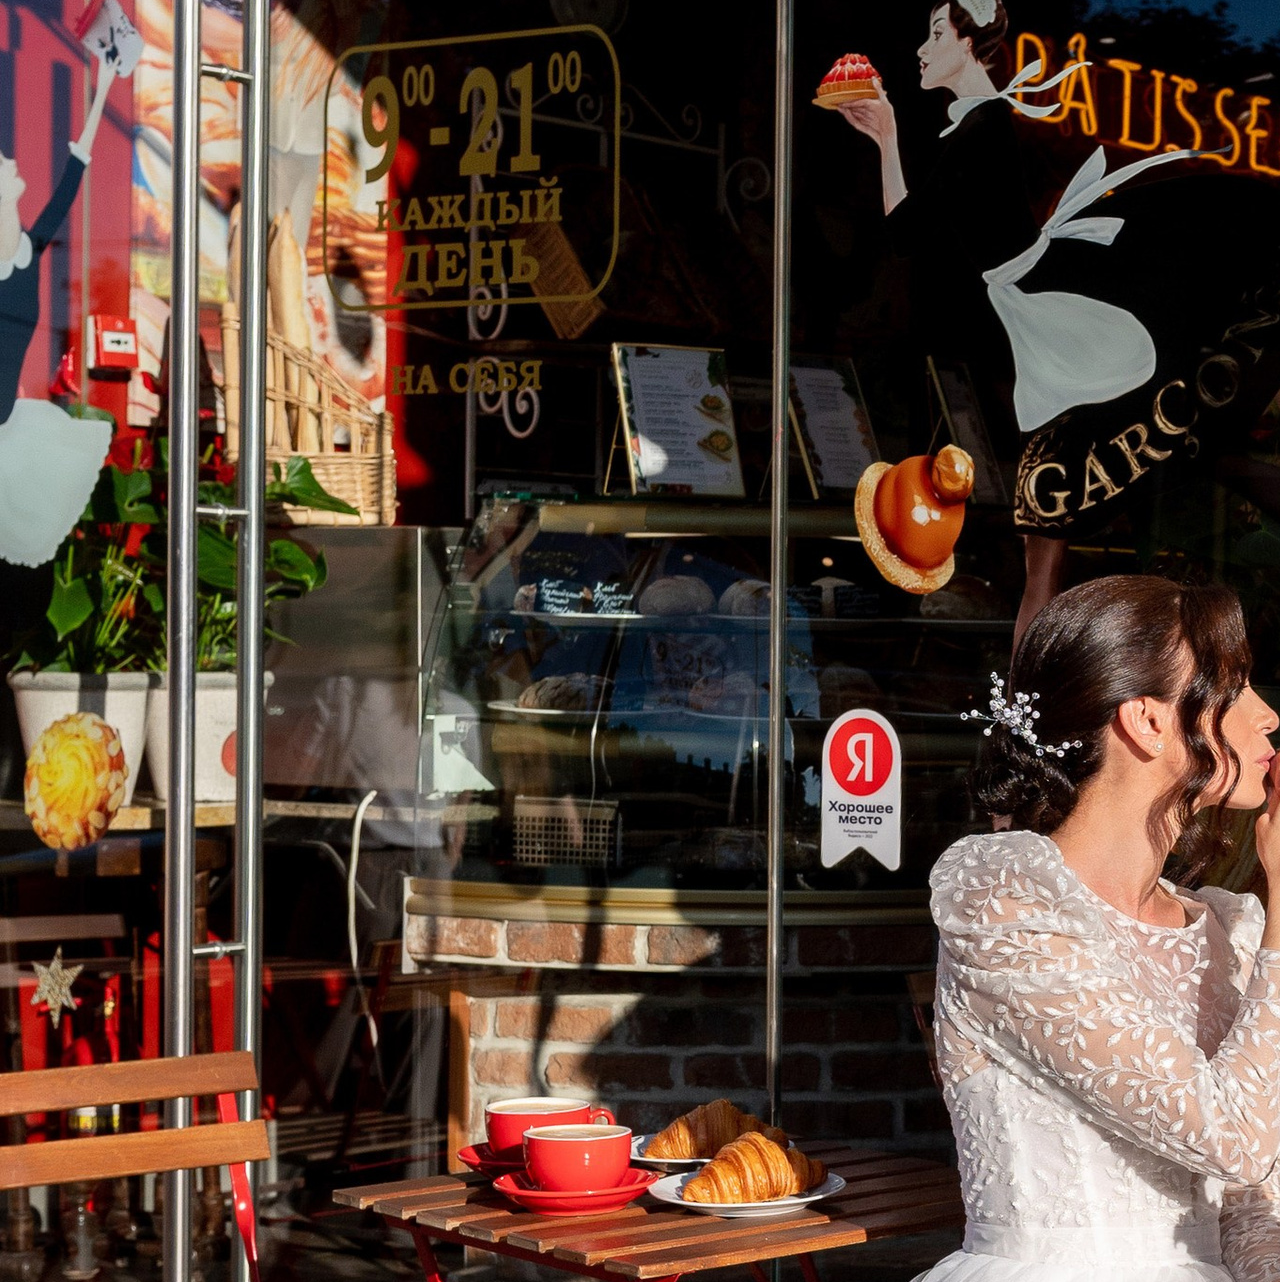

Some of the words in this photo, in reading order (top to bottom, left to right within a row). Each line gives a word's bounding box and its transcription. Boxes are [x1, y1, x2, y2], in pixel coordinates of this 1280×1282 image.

[375, 175, 563, 233] КАЖДЫЙ
[392, 238, 540, 297] ДЕНЬ
[390, 364, 438, 395] НА
[449, 360, 543, 394] СЕБЯ
[1022, 309, 1280, 518] GARÇON
[846, 732, 874, 783] Я
[828, 800, 894, 815] Хорошее
[838, 815, 883, 826] место
